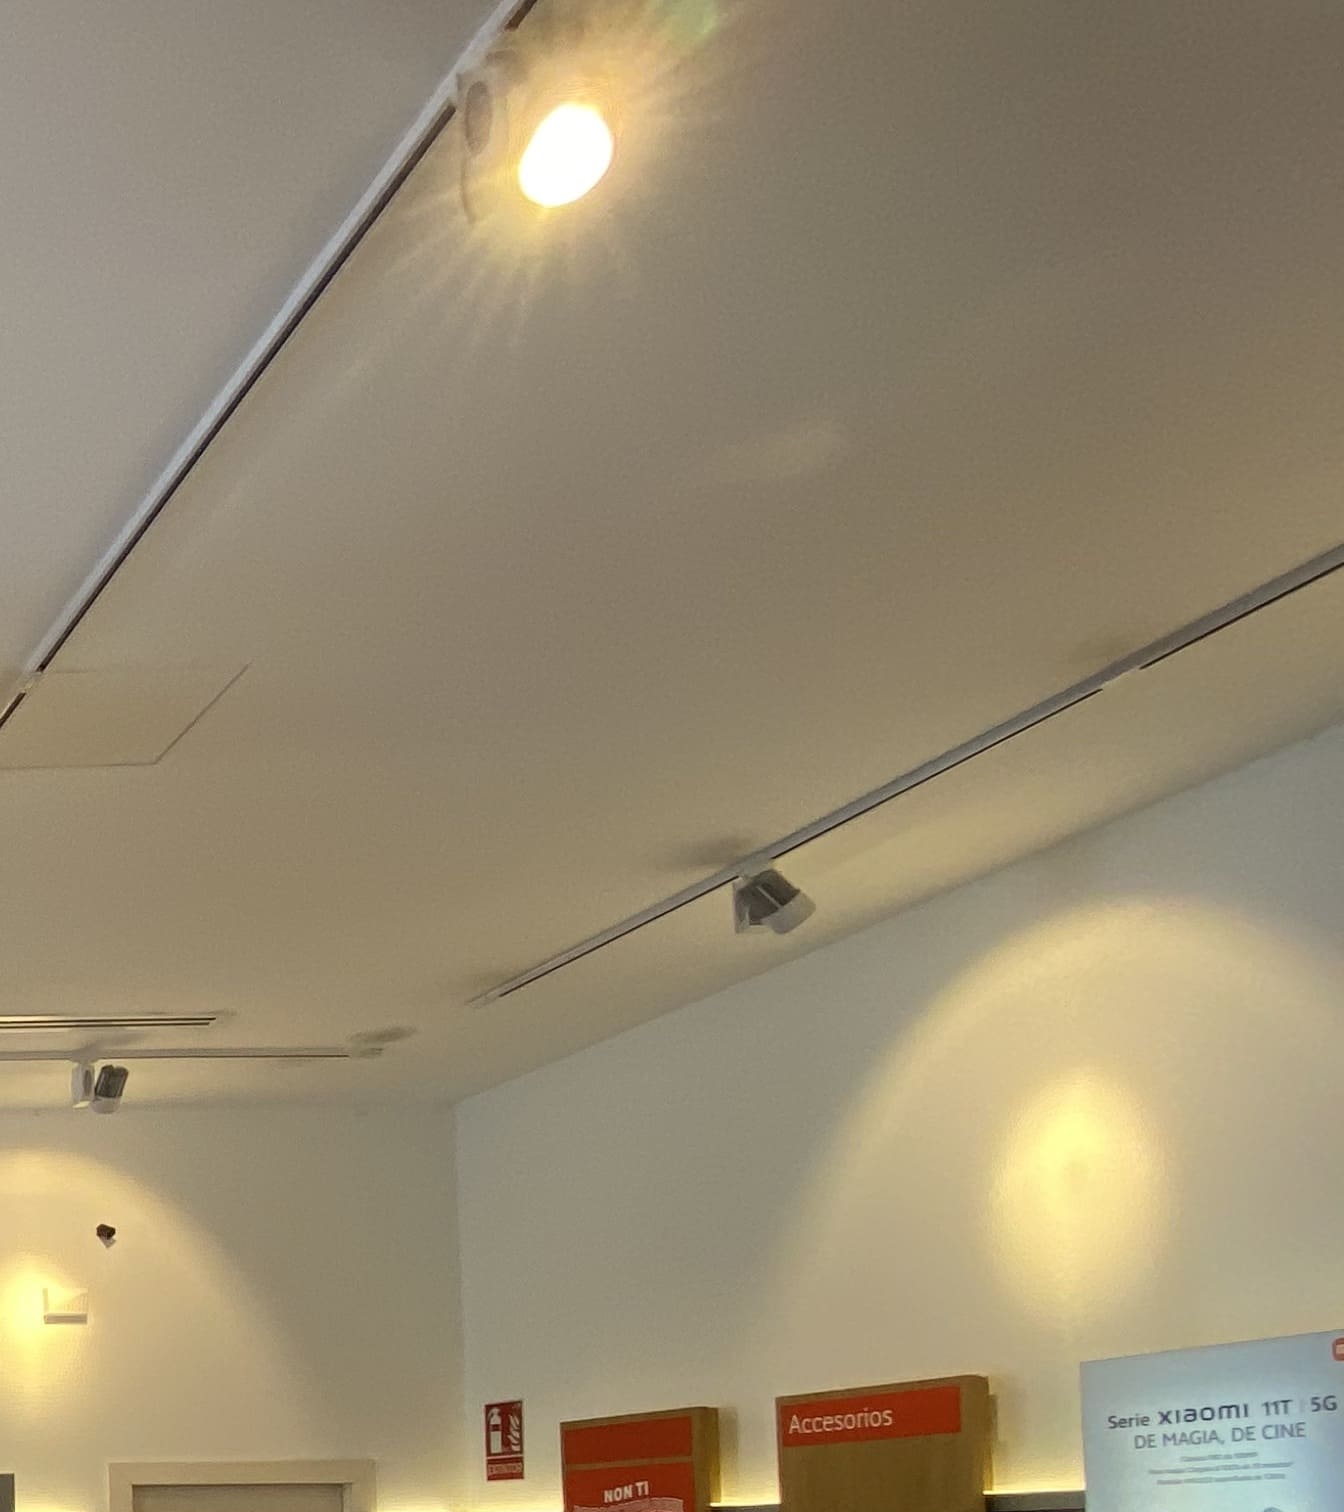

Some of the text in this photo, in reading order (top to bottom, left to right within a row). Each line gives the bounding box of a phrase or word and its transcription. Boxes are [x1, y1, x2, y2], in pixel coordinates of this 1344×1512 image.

[788, 1407, 893, 1435] Accesorios
[1108, 1413, 1150, 1430] Serie
[1261, 1399, 1294, 1417] 11T
[1310, 1395, 1338, 1412] 5G
[1134, 1422, 1307, 1449] DE MAGIA, DE CINE
[604, 1481, 649, 1503] NON TI
